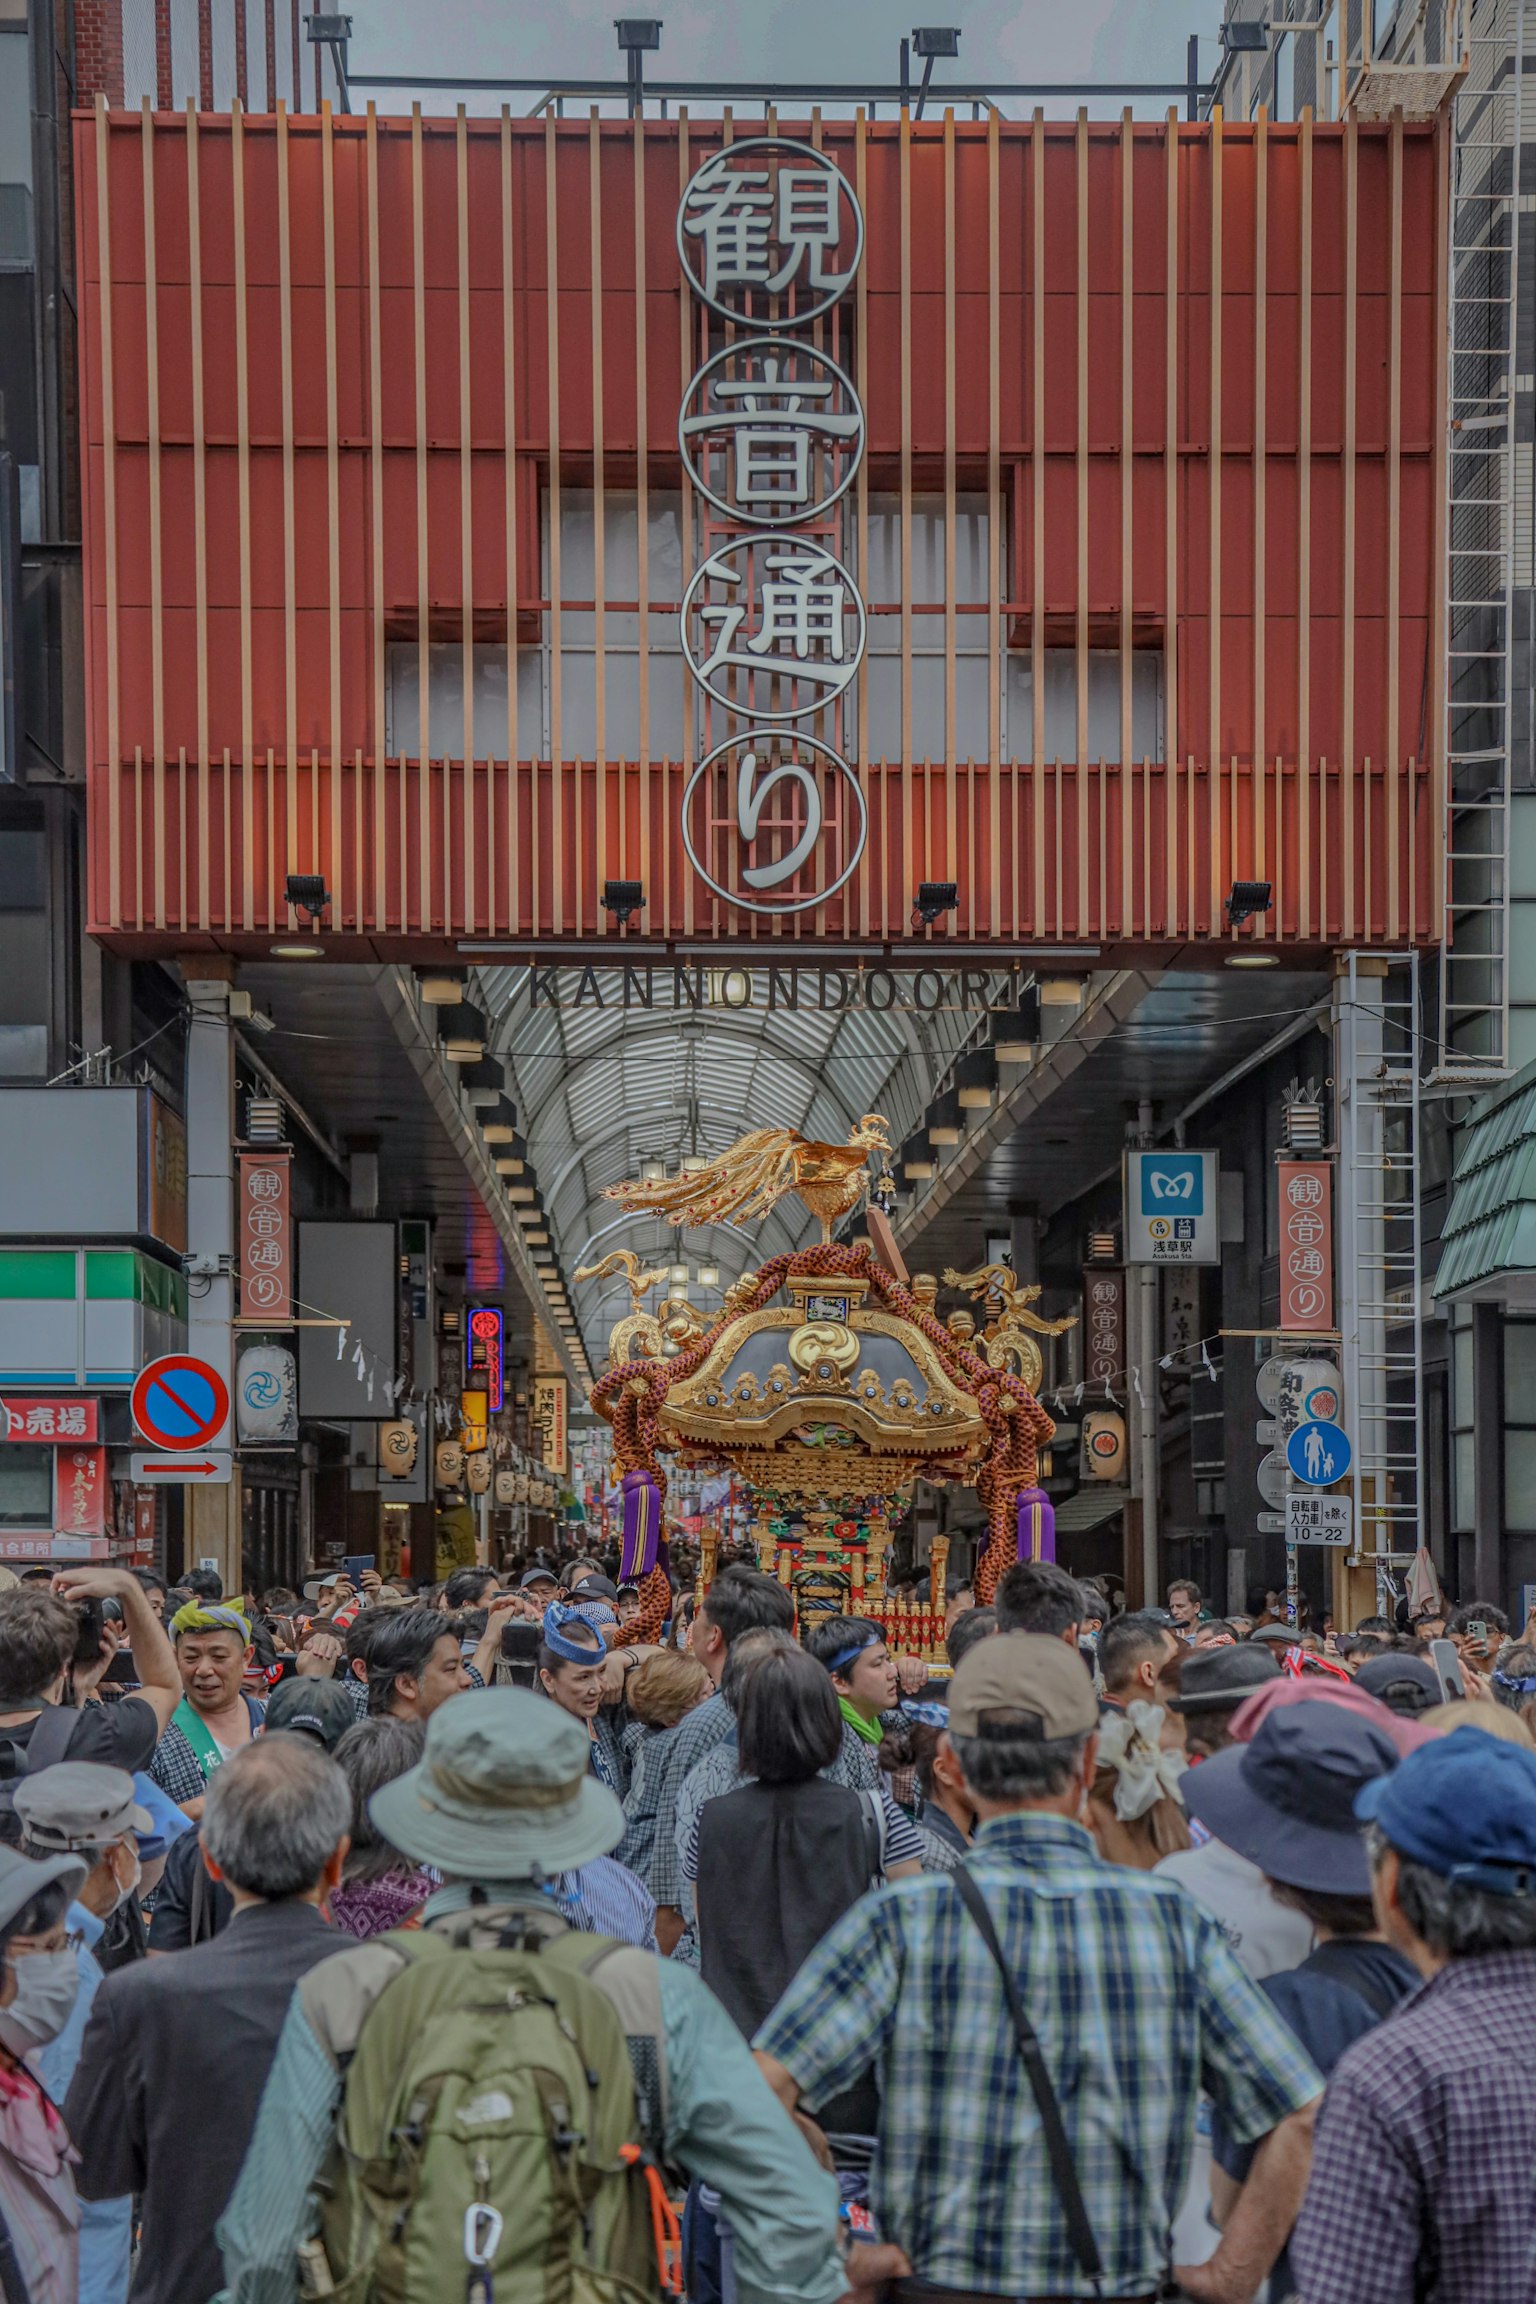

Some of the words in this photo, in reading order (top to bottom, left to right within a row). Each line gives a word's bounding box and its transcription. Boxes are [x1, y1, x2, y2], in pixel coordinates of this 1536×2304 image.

[682, 158, 862, 890] 観音通り
[530, 965, 1021, 1012] KANNONDOORI
[249, 1173, 282, 1304] 観音通り
[1153, 1240, 1193, 1253] 浅草駅
[1288, 1179, 1324, 1314] 観音通り
[1092, 1284, 1118, 1378] 観音通り
[1290, 1500, 1320, 1513] 自転車
[1290, 1512, 1320, 1526] 人力車
[1324, 1507, 1347, 1521] を除く
[0, 1541, 50, 1556] 合場所
